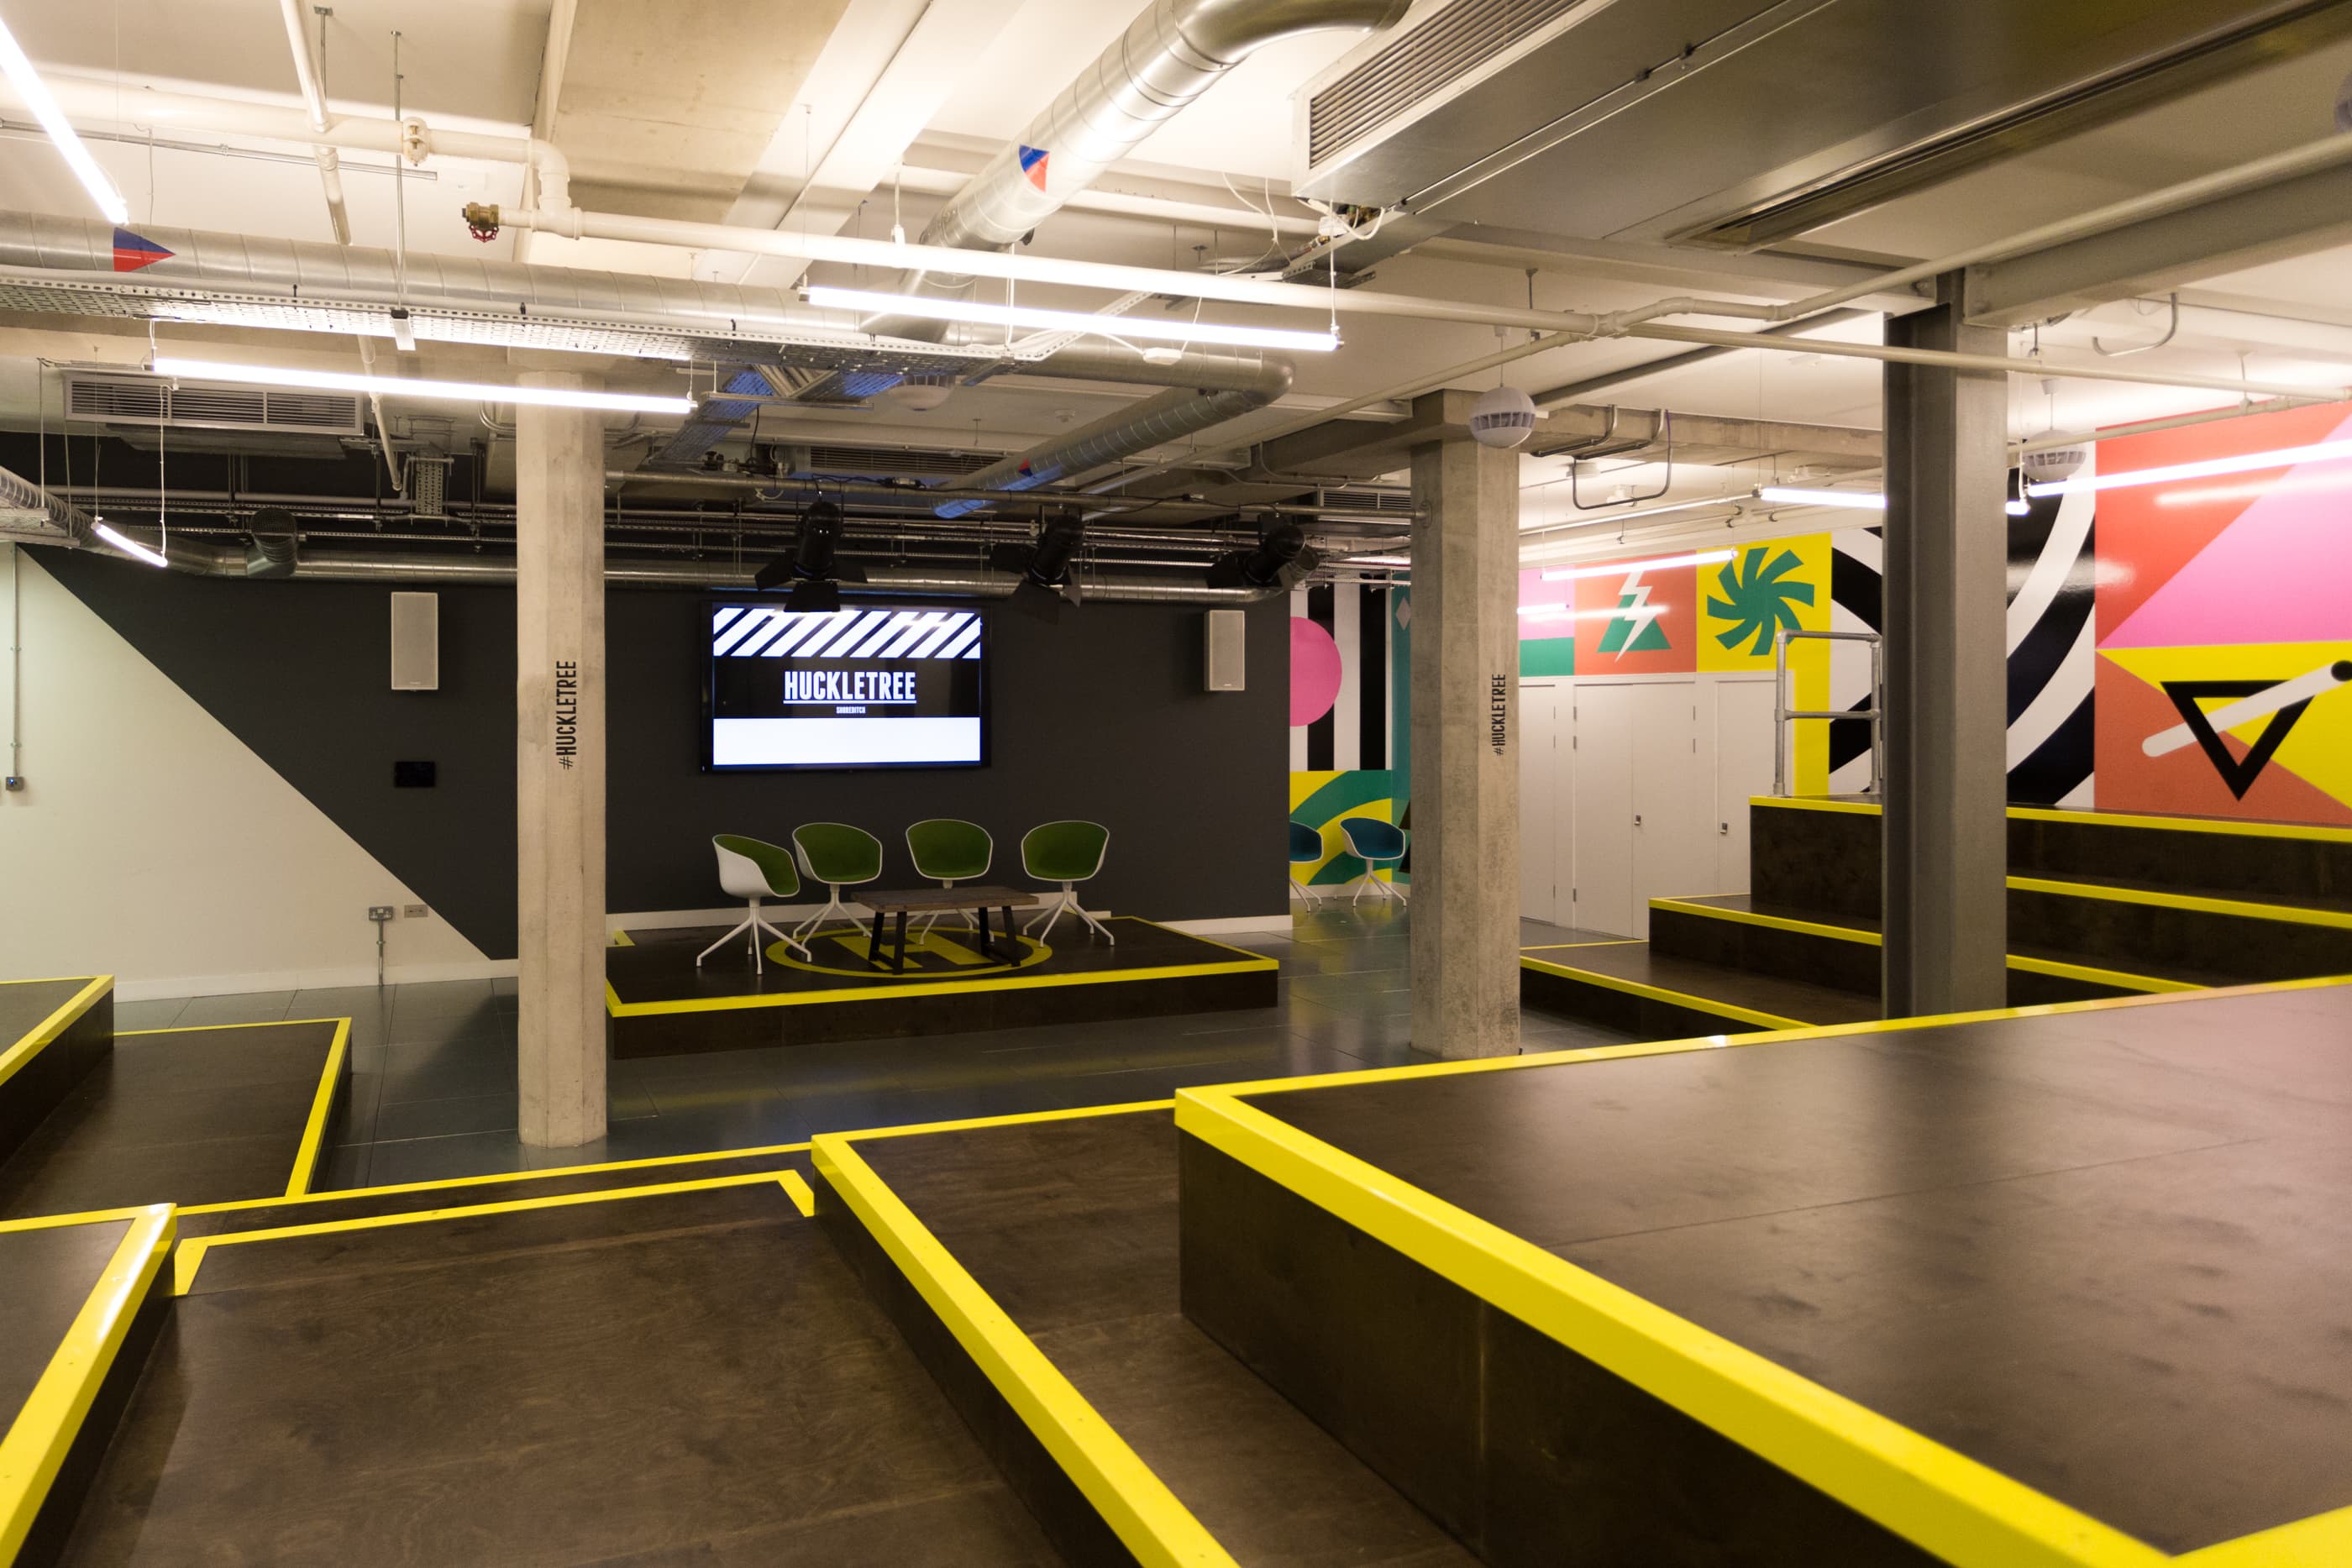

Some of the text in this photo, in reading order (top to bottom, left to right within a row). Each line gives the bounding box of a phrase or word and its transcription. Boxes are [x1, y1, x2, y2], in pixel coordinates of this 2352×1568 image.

[556, 660, 577, 770] #HUCKLETREE
[785, 671, 916, 700] HUCKLETREE
[1491, 674, 1506, 757] #HUCKLETREE
